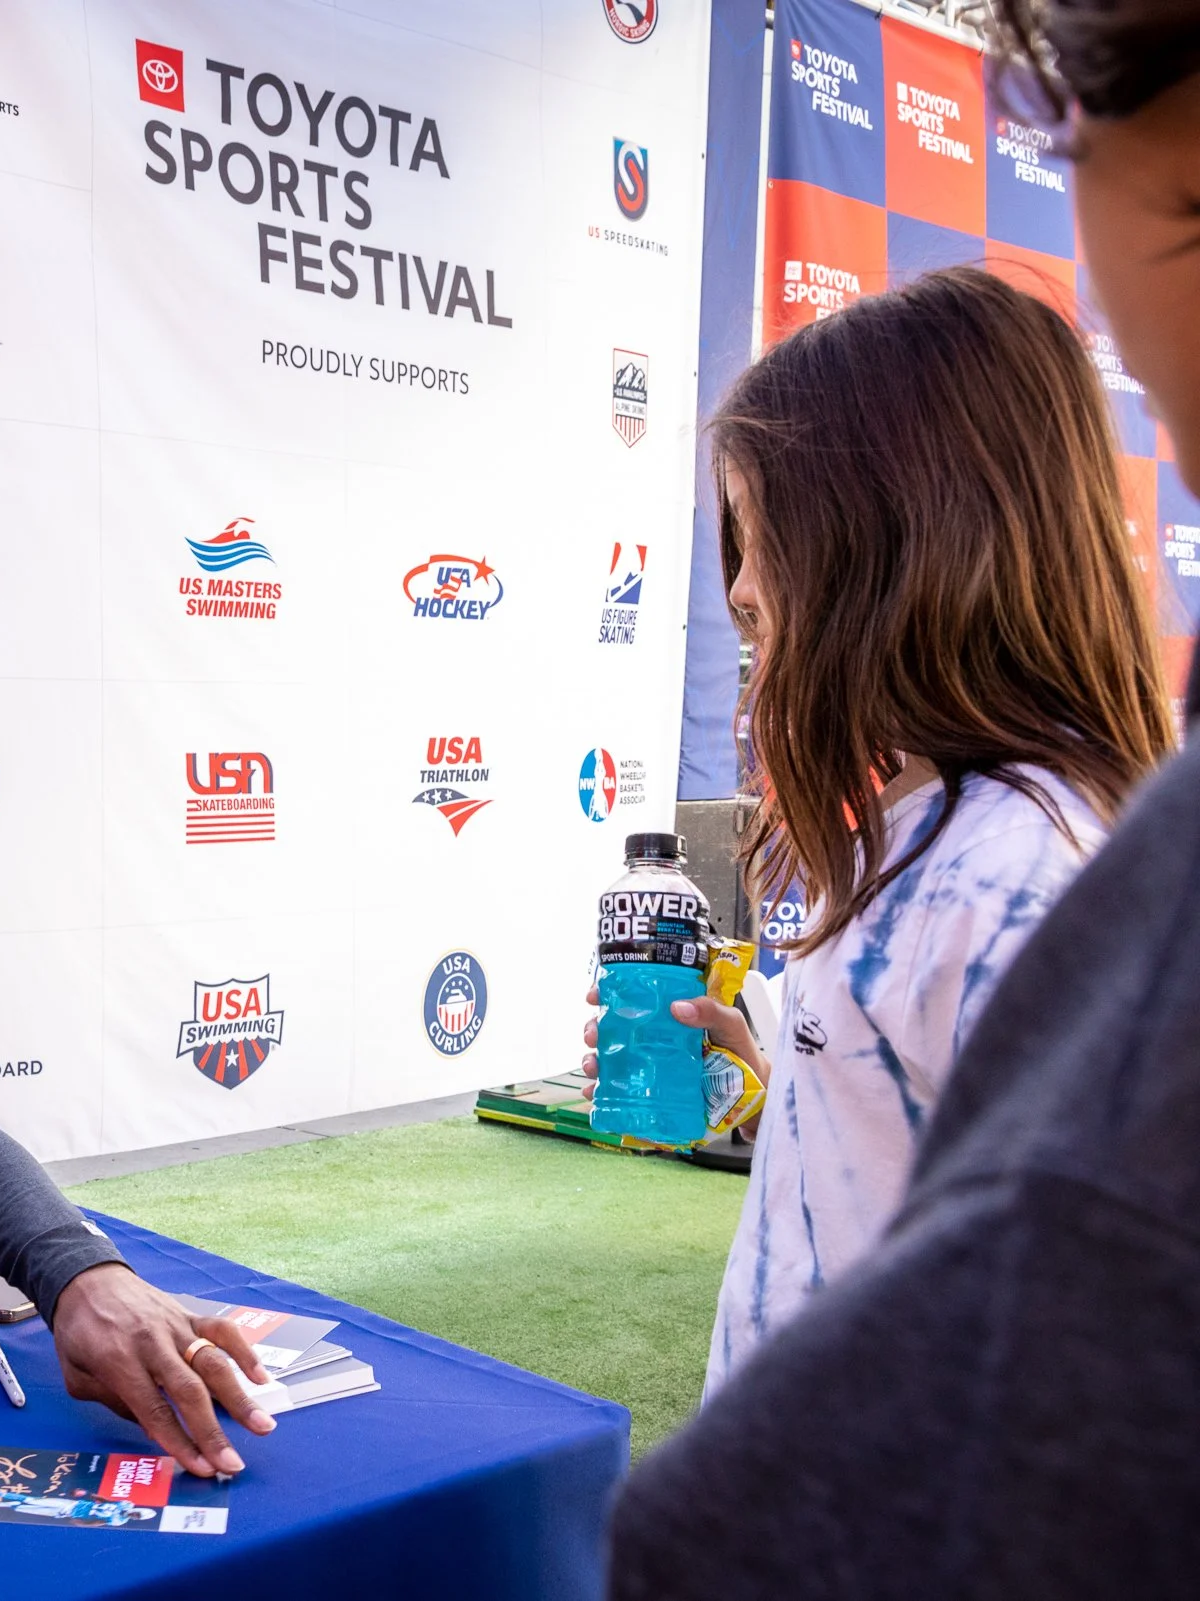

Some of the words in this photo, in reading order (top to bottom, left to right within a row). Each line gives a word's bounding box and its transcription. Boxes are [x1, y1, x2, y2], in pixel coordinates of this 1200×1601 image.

[792, 60, 840, 97] SPORTS
[804, 44, 858, 84] TOYOTA
[206, 58, 450, 180] TOYOTA
[812, 90, 873, 130] FESTIVAL
[897, 102, 944, 134] SPORTS
[909, 86, 961, 121] TOYOTA
[918, 129, 974, 164] FESTIVAL
[996, 135, 1039, 166] SPORTS
[1008, 121, 1054, 152] TOYOTA
[144, 119, 373, 231] SPORTS
[1015, 160, 1065, 193] FESTIVAL
[588, 225, 600, 239] US
[257, 222, 513, 329] FESTIVAL
[806, 262, 860, 294] TOYOTA
[784, 282, 844, 309] SPORTS
[262, 339, 363, 378] PROUDLY
[369, 357, 469, 395] SUPPORTS
[179, 577, 204, 596] U.S.
[207, 579, 282, 600] MASTERS
[186, 599, 276, 619] SWIMMING
[413, 597, 492, 620] HOCKEY
[612, 609, 638, 626] FIGURE
[598, 625, 636, 645] SKATING
[426, 736, 482, 765] USA
[420, 768, 490, 783] TRIATHLON
[196, 797, 275, 811] SKATEBOARDING
[601, 893, 698, 920] POWER
[600, 916, 650, 941] ADE
[442, 956, 471, 975] USA
[601, 952, 623, 962] SPORTS
[624, 952, 649, 962] DRINK
[202, 987, 262, 1022] USA
[186, 1018, 275, 1044] SWIMMING
[429, 1015, 482, 1052] CURLING
[110, 1460, 138, 1498] ENGLISH
[134, 1457, 157, 1486] LARRY
